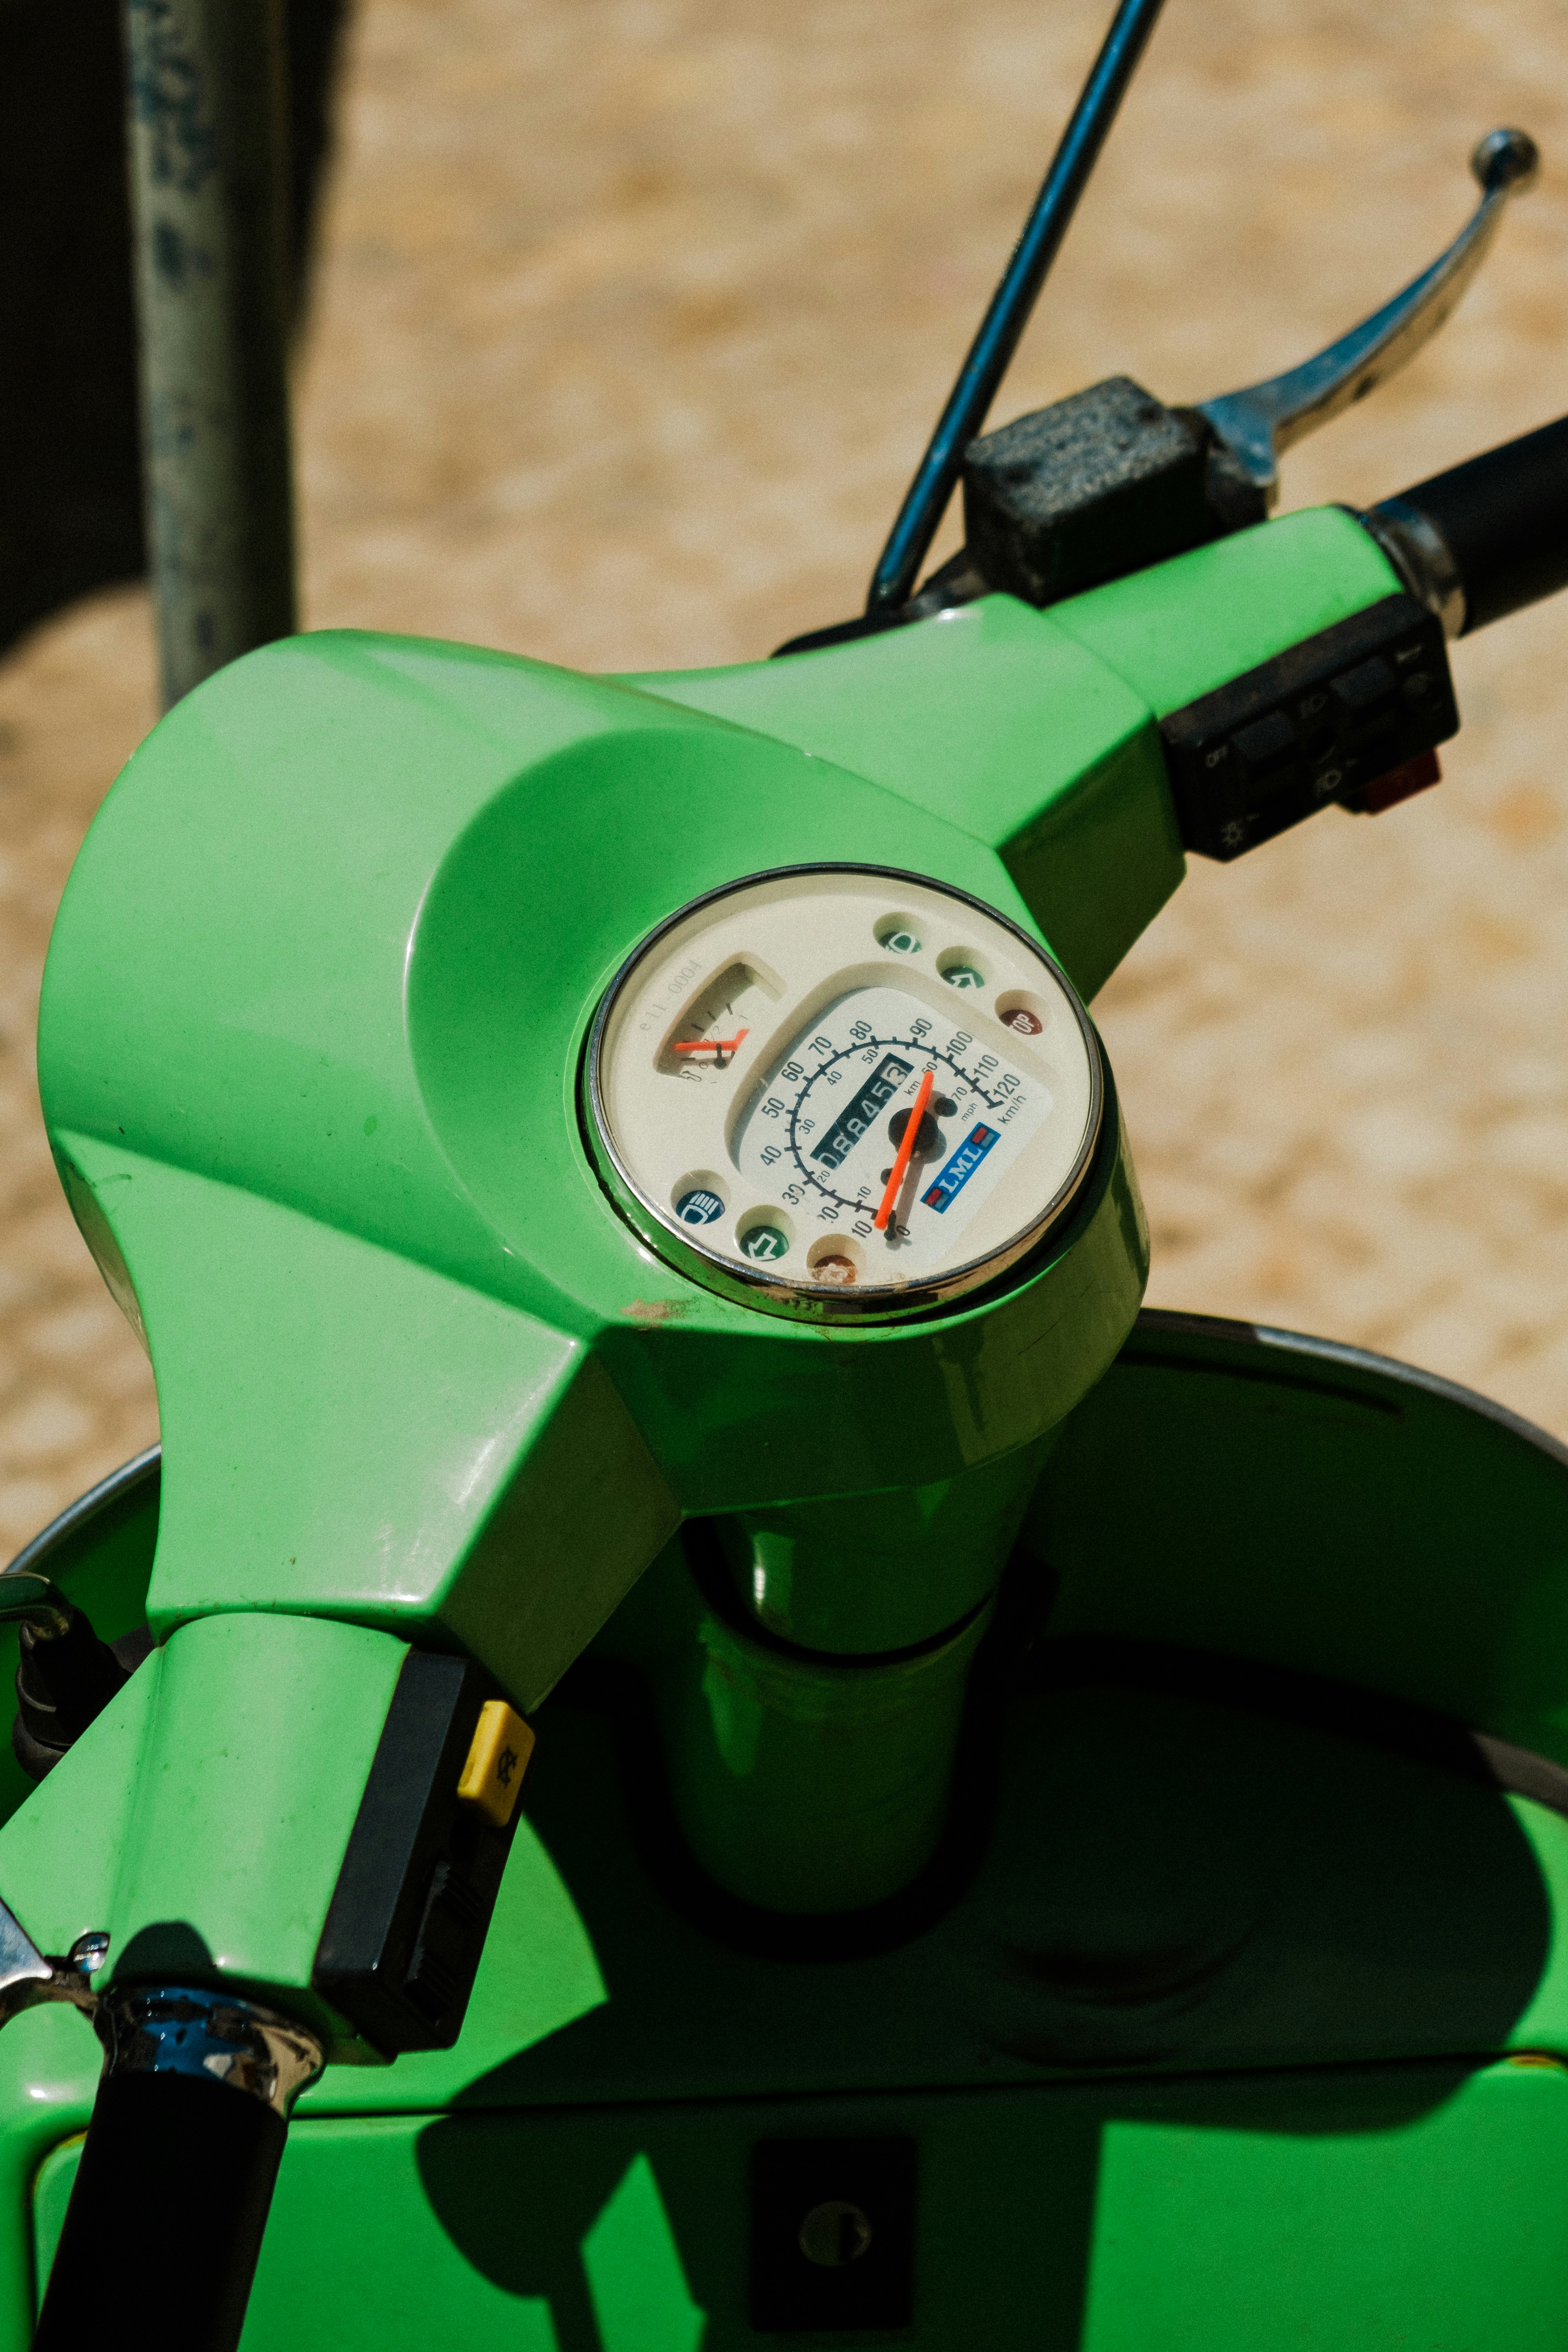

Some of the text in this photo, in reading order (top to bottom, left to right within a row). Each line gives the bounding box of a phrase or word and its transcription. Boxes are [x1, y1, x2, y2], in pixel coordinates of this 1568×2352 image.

[849, 1020, 872, 1040] 80
[910, 1018, 933, 1038] 90
[808, 1036, 832, 1056] 70
[946, 1031, 973, 1055] 100
[861, 1049, 878, 1064] 50
[974, 1055, 999, 1078] 110
[781, 1061, 804, 1082] 60
[827, 1071, 842, 1086] 40
[903, 1080, 921, 1096] km
[951, 1087, 968, 1101] 70
[993, 1074, 1021, 1099] 120
[761, 1097, 785, 1118] 50
[961, 1102, 978, 1122] mph
[997, 1095, 1027, 1125] km/h
[799, 1119, 815, 1134] 30
[760, 1145, 782, 1166] 40
[817, 1170, 830, 1183] 20
[939, 1147, 983, 1193] LML
[857, 1186, 872, 1200] 10
[852, 1220, 873, 1239] 10
[896, 1225, 911, 1236] 0
